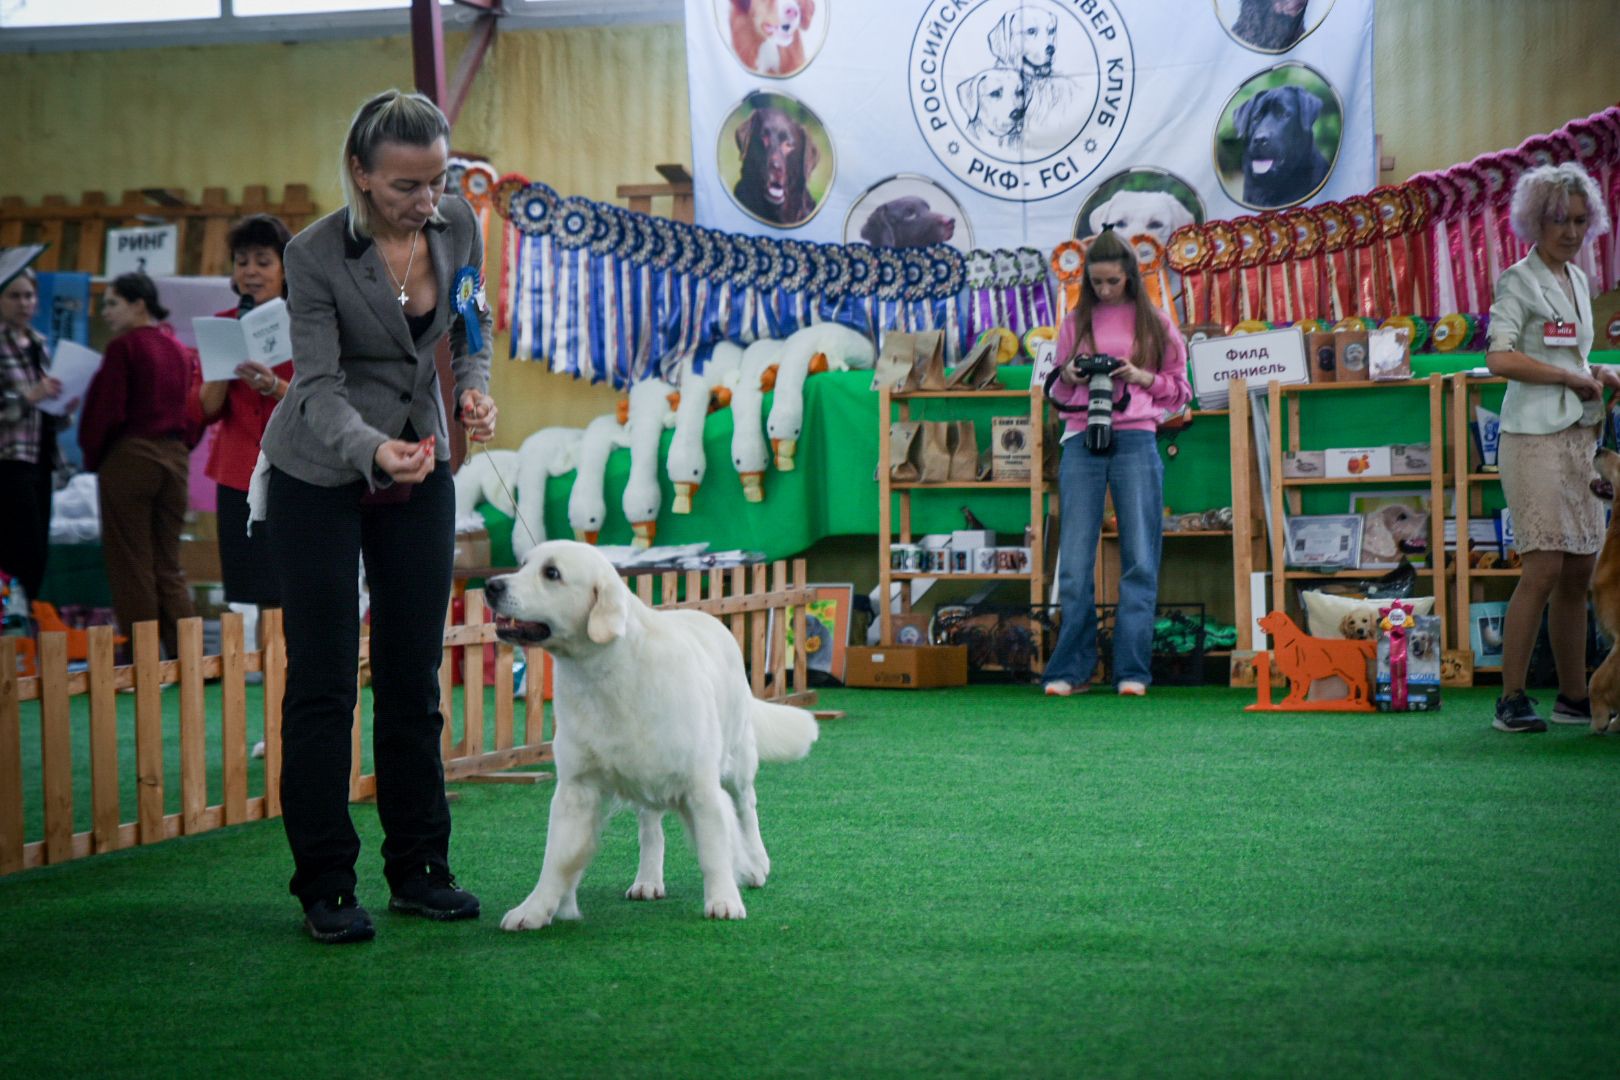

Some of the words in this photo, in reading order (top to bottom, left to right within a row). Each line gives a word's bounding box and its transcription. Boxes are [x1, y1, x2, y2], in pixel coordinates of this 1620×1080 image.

[921, 0, 969, 131] РОССИЙСК
[1074, 0, 1116, 41] ВЕР
[1098, 57, 1124, 129] КЛУБ
[1039, 156, 1079, 189] FCI
[117, 231, 169, 252] РИНГ
[1226, 347, 1269, 361] Филд
[1213, 363, 1286, 382] спаниель
